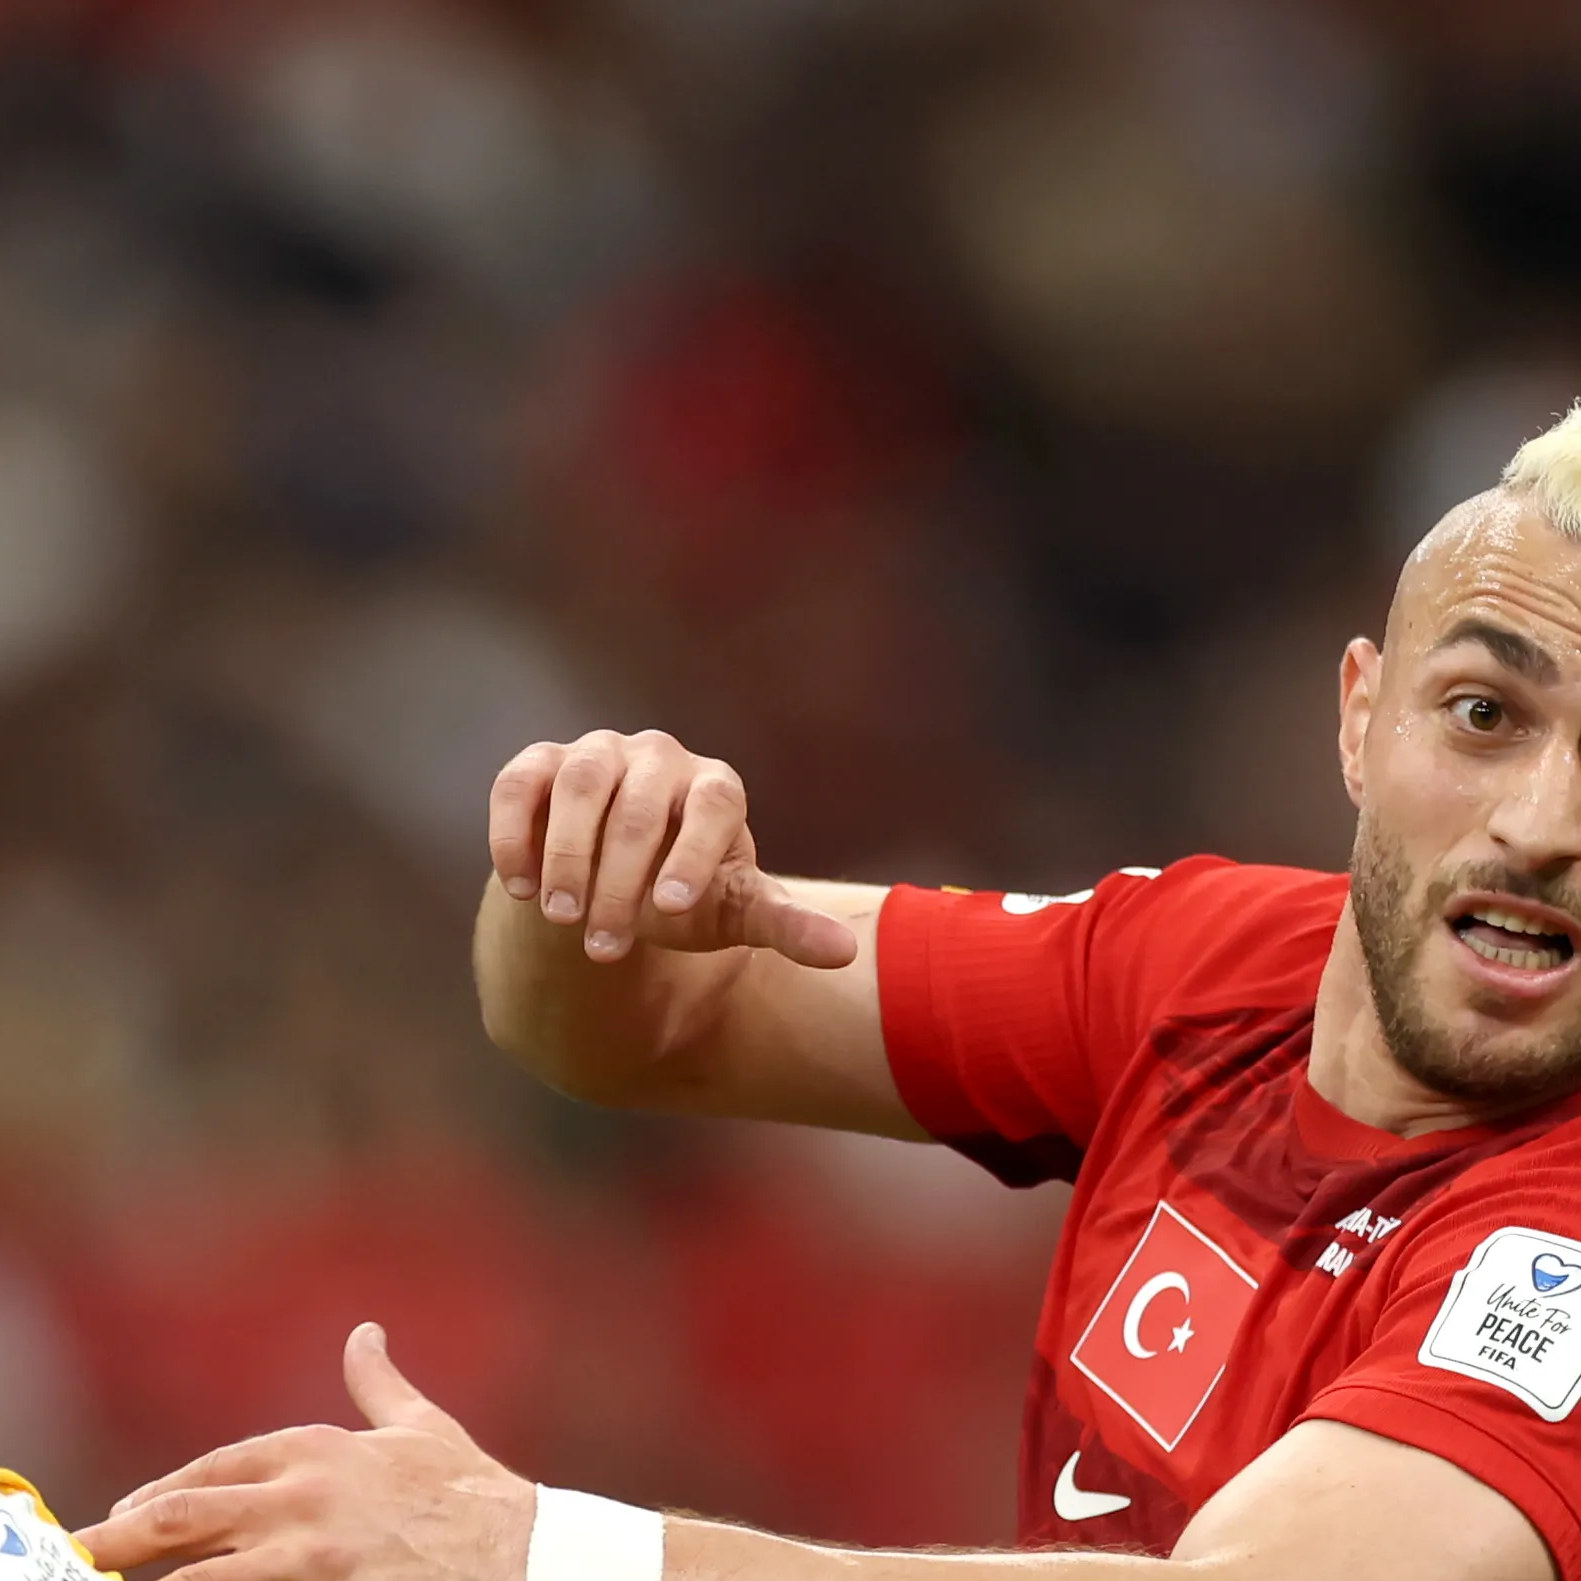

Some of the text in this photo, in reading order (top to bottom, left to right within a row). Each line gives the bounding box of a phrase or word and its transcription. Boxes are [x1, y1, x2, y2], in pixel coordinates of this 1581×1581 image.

[1486, 1283, 1572, 1335] Unite For
[1476, 1313, 1555, 1363] PEACE
[1478, 1345, 1516, 1370] FIFA
